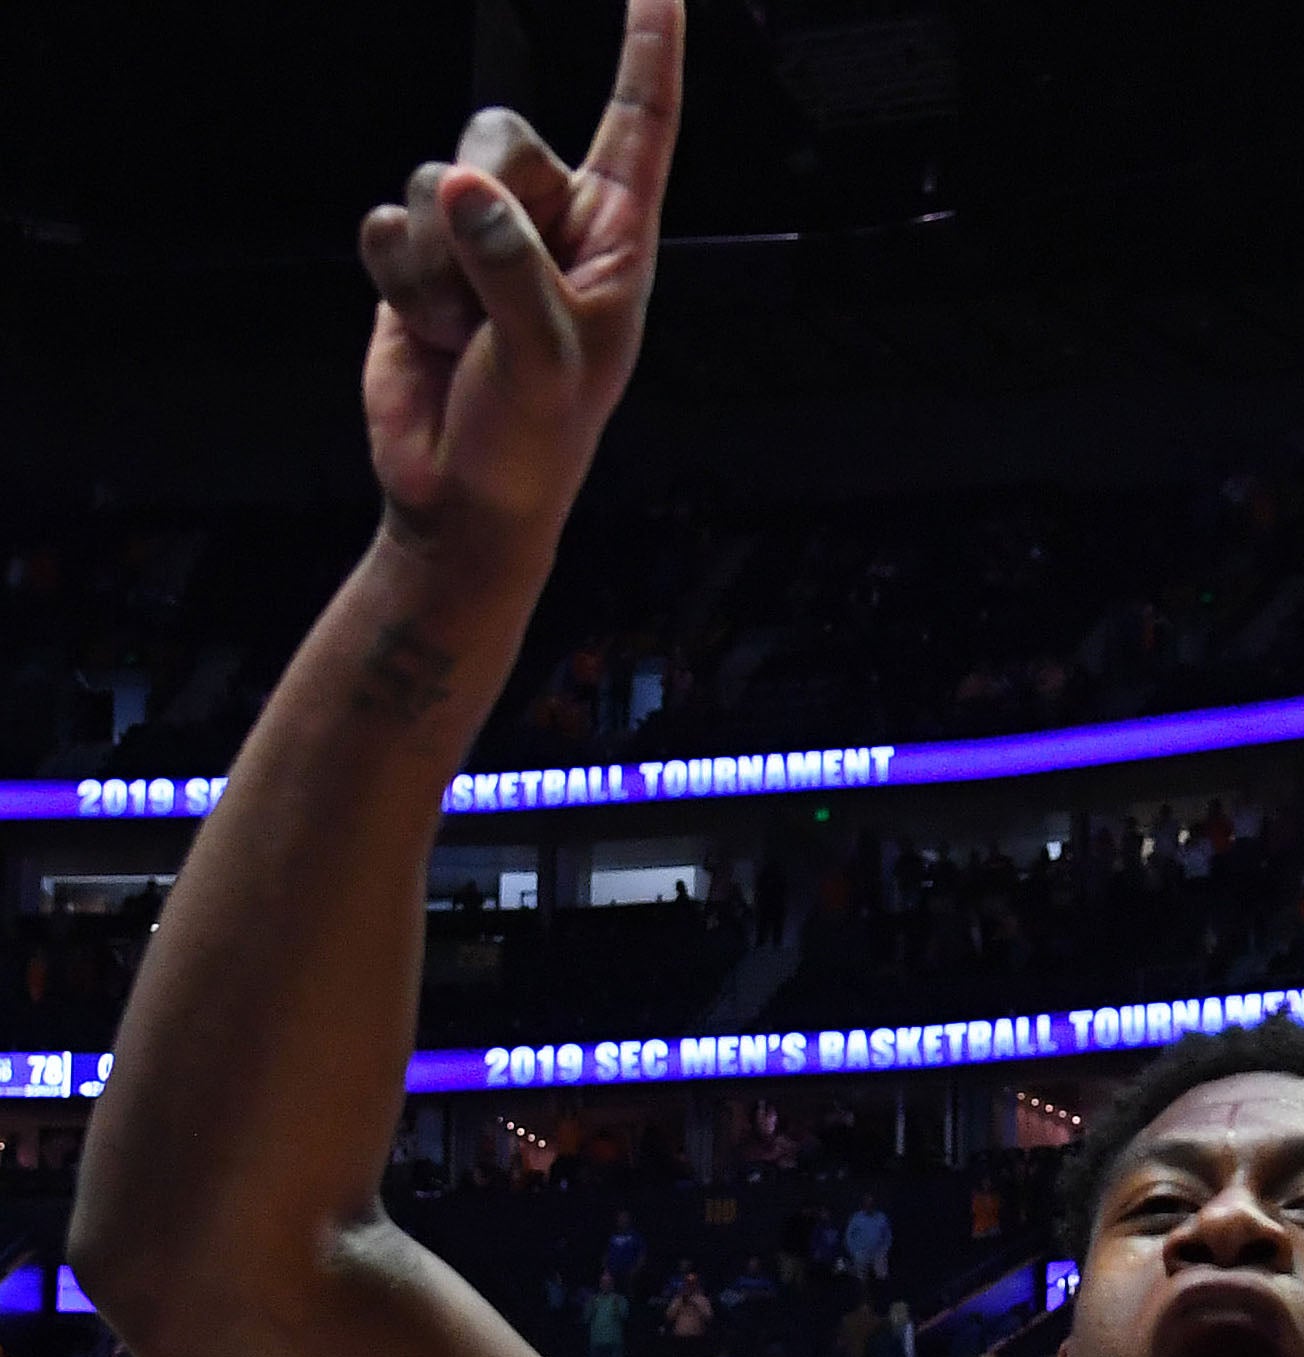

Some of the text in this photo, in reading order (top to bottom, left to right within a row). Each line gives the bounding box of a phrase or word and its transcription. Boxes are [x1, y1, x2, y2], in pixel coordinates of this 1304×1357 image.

[77, 778, 174, 816] 2019
[639, 746, 895, 797] TOURNAMENT
[484, 1043, 583, 1087] 2019
[595, 1039, 668, 1081] SEC
[680, 1032, 807, 1076] MEN'S
[818, 1014, 1057, 1071] BASKETBALL
